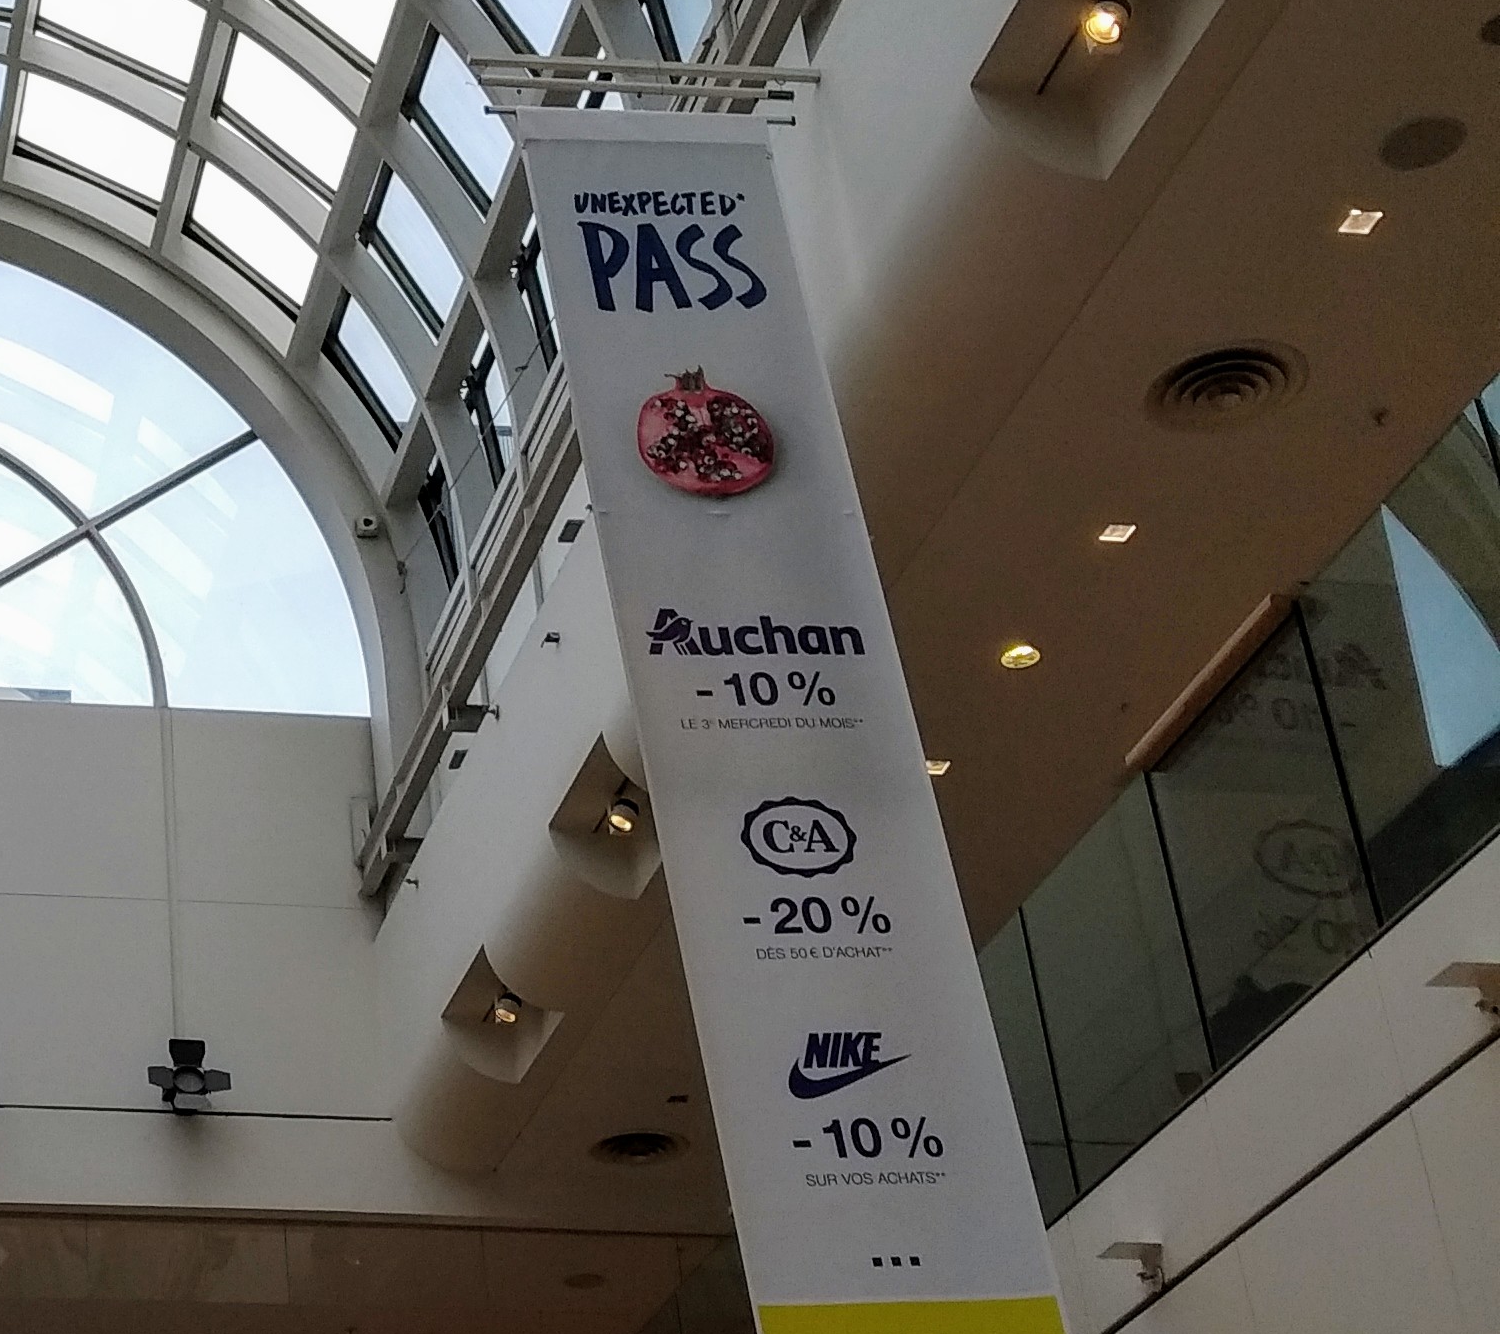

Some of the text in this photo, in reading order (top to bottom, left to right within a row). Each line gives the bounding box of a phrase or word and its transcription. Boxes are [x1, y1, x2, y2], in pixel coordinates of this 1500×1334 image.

[577, 221, 768, 312] PASS
[646, 608, 865, 656] Auchan
[681, 719, 699, 730] LE
[719, 717, 792, 730] MERCREDI
[796, 717, 815, 728] DU
[762, 819, 839, 853] C&A
[756, 946, 785, 960] DÈS
[803, 1032, 882, 1069] NIKE
[806, 1173, 838, 1187] SUR
[842, 1173, 874, 1186] VOS
